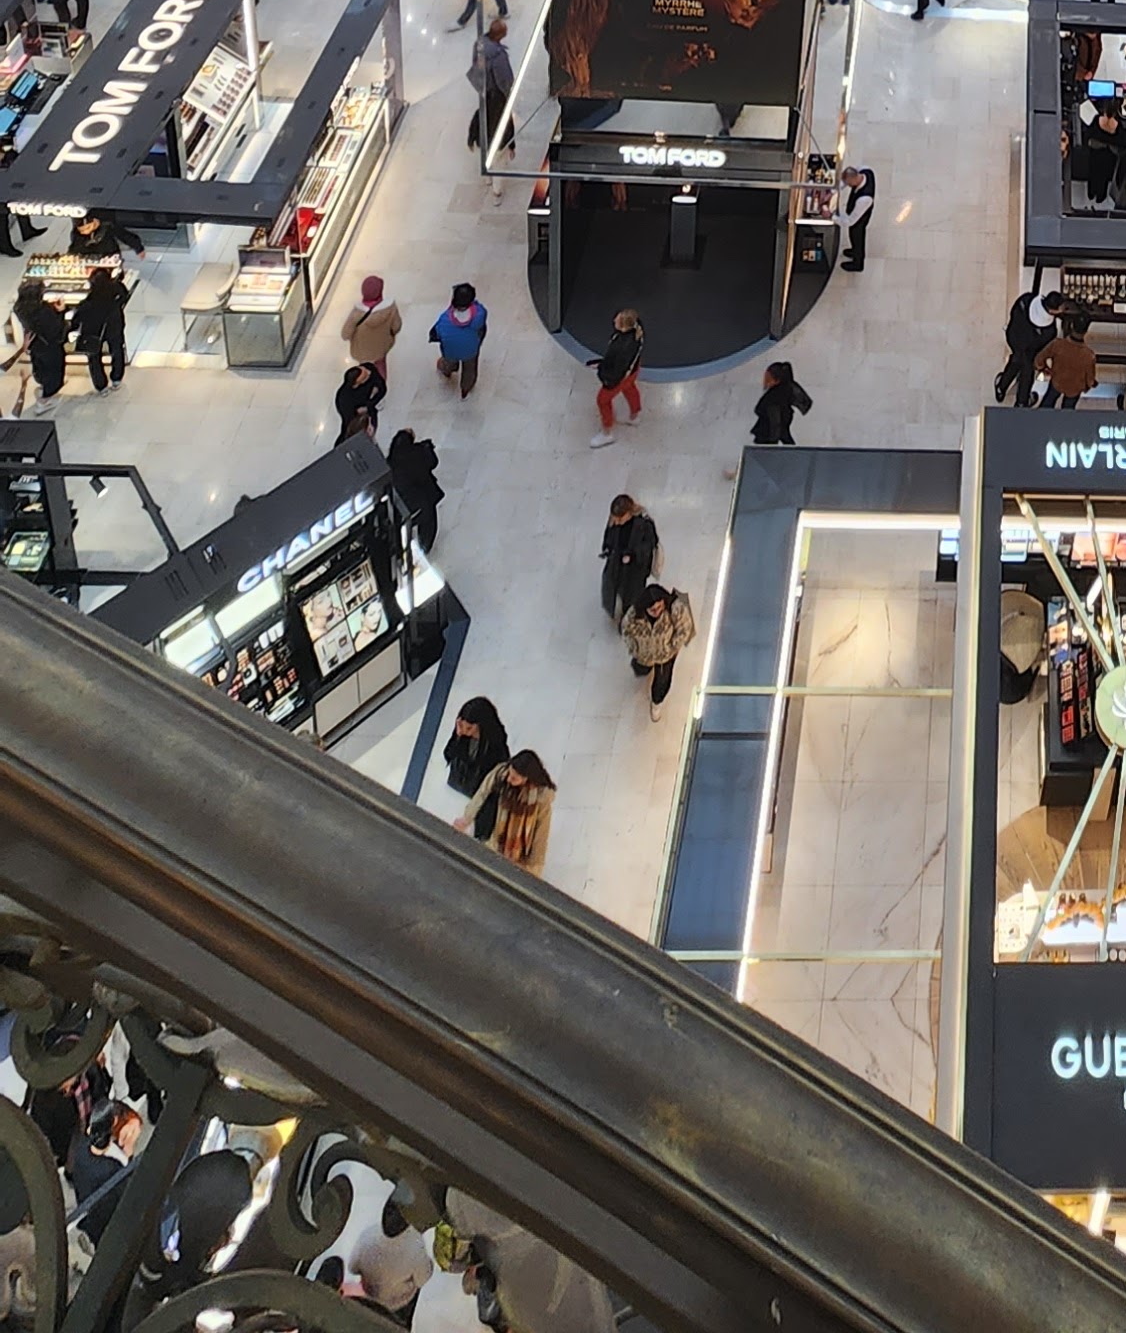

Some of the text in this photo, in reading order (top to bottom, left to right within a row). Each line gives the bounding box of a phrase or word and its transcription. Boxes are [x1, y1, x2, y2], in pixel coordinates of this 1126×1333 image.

[675, 24, 709, 33] PARFUM
[48, 79, 149, 172] TOM
[618, 145, 727, 168] TOM FORD
[7, 201, 88, 219] TOM FORD
[236, 490, 375, 593] CHANEL
